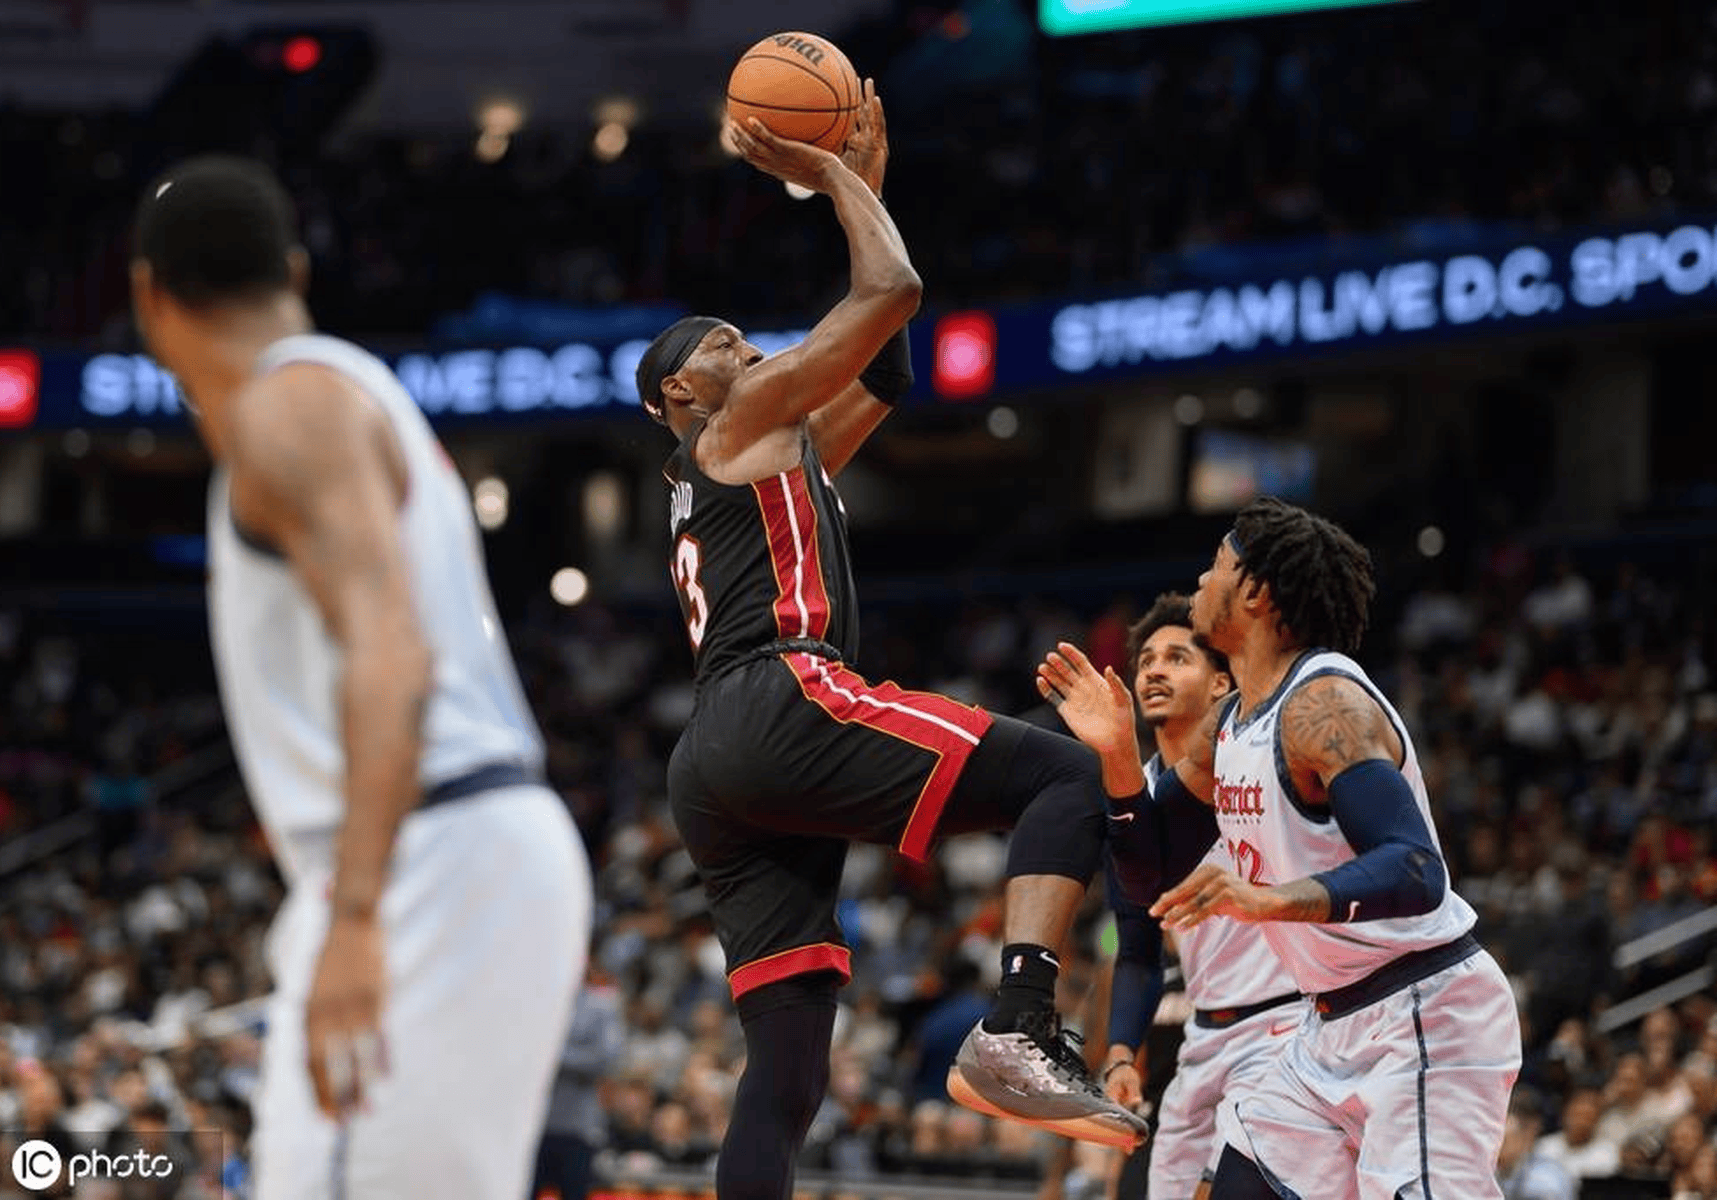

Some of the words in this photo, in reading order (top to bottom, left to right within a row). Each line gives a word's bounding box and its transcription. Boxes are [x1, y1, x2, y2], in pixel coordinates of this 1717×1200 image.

[1051, 279, 1297, 372] STREAM
[1300, 262, 1439, 343] LIVE
[1570, 223, 1717, 308] SPO
[670, 533, 708, 648] 3
